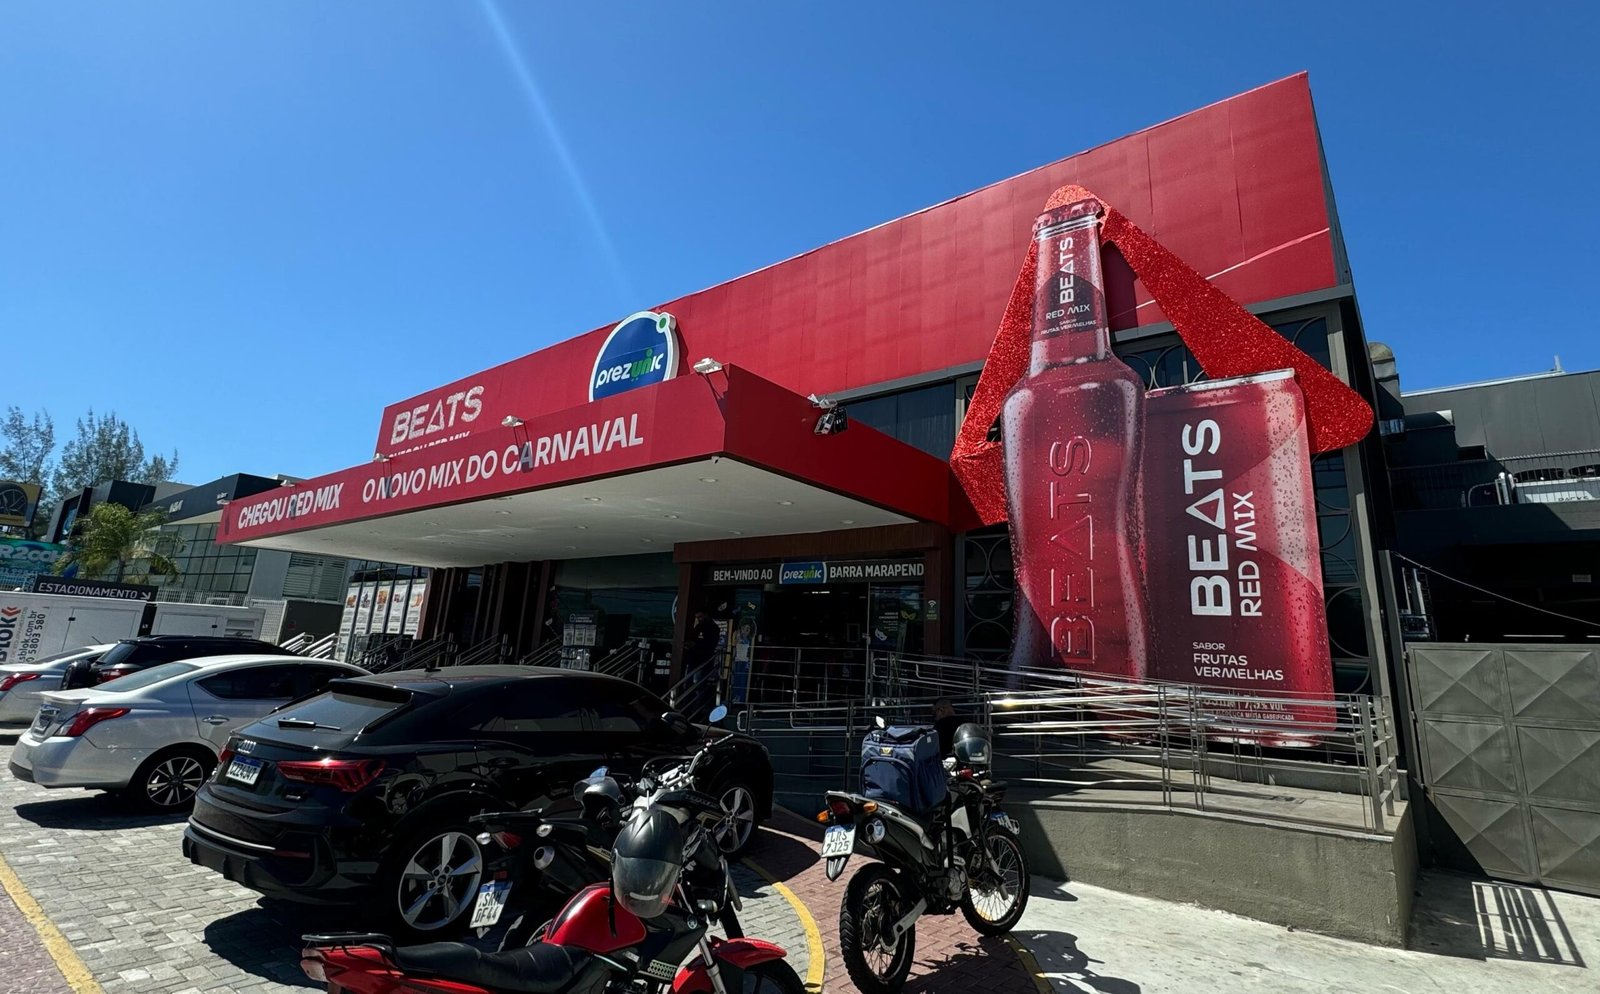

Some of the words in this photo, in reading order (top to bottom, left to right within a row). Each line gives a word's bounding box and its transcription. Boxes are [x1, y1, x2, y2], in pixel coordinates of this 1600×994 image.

[1060, 237, 1074, 305] BEATS
[1046, 309, 1065, 321] RED
[1067, 303, 1091, 315] MIX
[1040, 326, 1059, 335] FRUTAS
[1060, 319, 1096, 331] VERMELHAS
[595, 348, 664, 389] prezunic
[390, 386, 485, 446] BEATS
[238, 496, 288, 529] CHEGOU
[286, 490, 314, 519] RED
[313, 482, 344, 513] MIX
[362, 478, 376, 503] O
[375, 468, 426, 501] NOVO
[427, 458, 464, 491] MIX
[465, 450, 498, 483] DO
[501, 413, 644, 475] CARNAVAL
[1181, 419, 1232, 616] BEATS
[1232, 490, 1258, 552] MIX
[1049, 435, 1095, 665] BEATS
[713, 568, 760, 581] BEM-VINDO
[760, 568, 773, 581] AO
[782, 564, 823, 580] prezunic
[829, 565, 863, 578] BARRA
[865, 562, 925, 577] MARAPEND
[38, 582, 138, 599] ESTACIONAMENTO
[1238, 560, 1263, 617] RED
[34, 613, 46, 630] 580
[1192, 641, 1226, 651] SABOR
[1193, 653, 1248, 666] FRUTAS
[1194, 666, 1284, 681] VERMELHAS
[830, 830, 848, 842] LRS
[825, 840, 850, 854] 7J25
